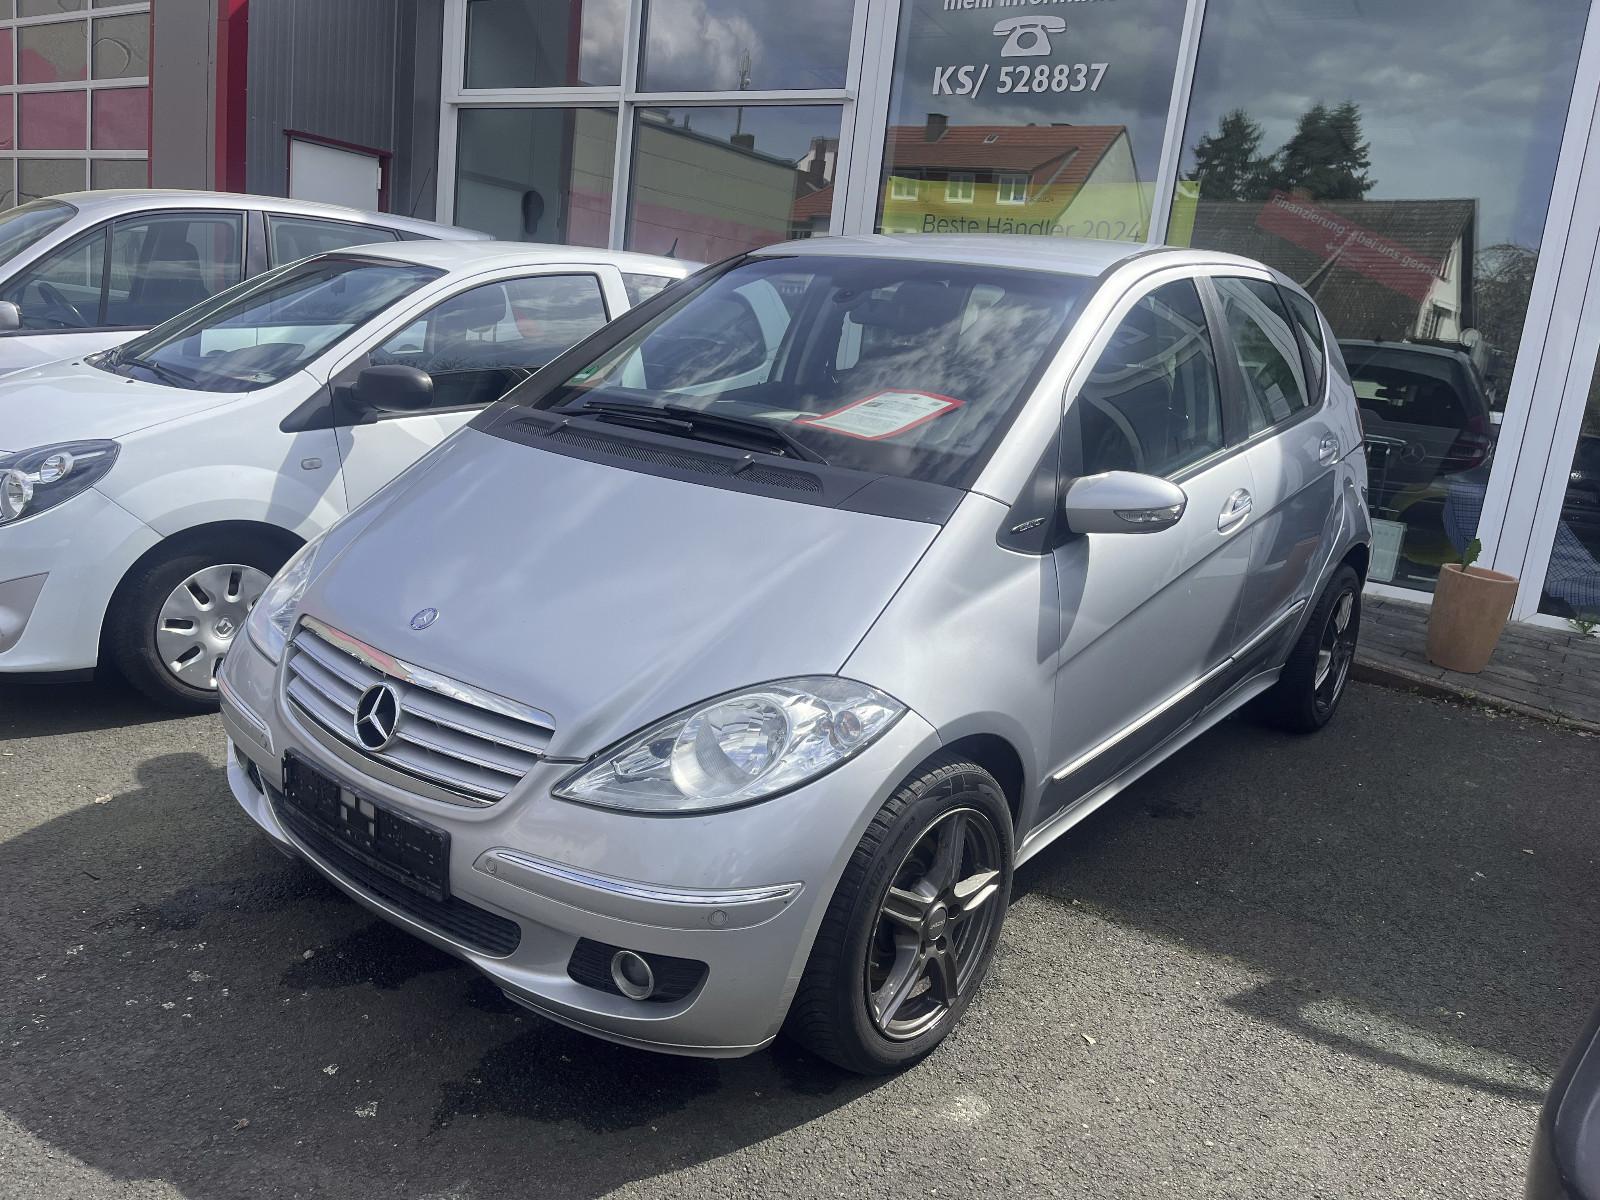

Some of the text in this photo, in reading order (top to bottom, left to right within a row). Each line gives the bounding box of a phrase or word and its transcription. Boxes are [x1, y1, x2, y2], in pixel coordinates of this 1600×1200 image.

[932, 62, 1110, 99] KS/ 528837
[921, 213, 1141, 243] Beste Händler 2024
[1271, 194, 1345, 237] Finanzierung
[1379, 244, 1401, 260] uns
